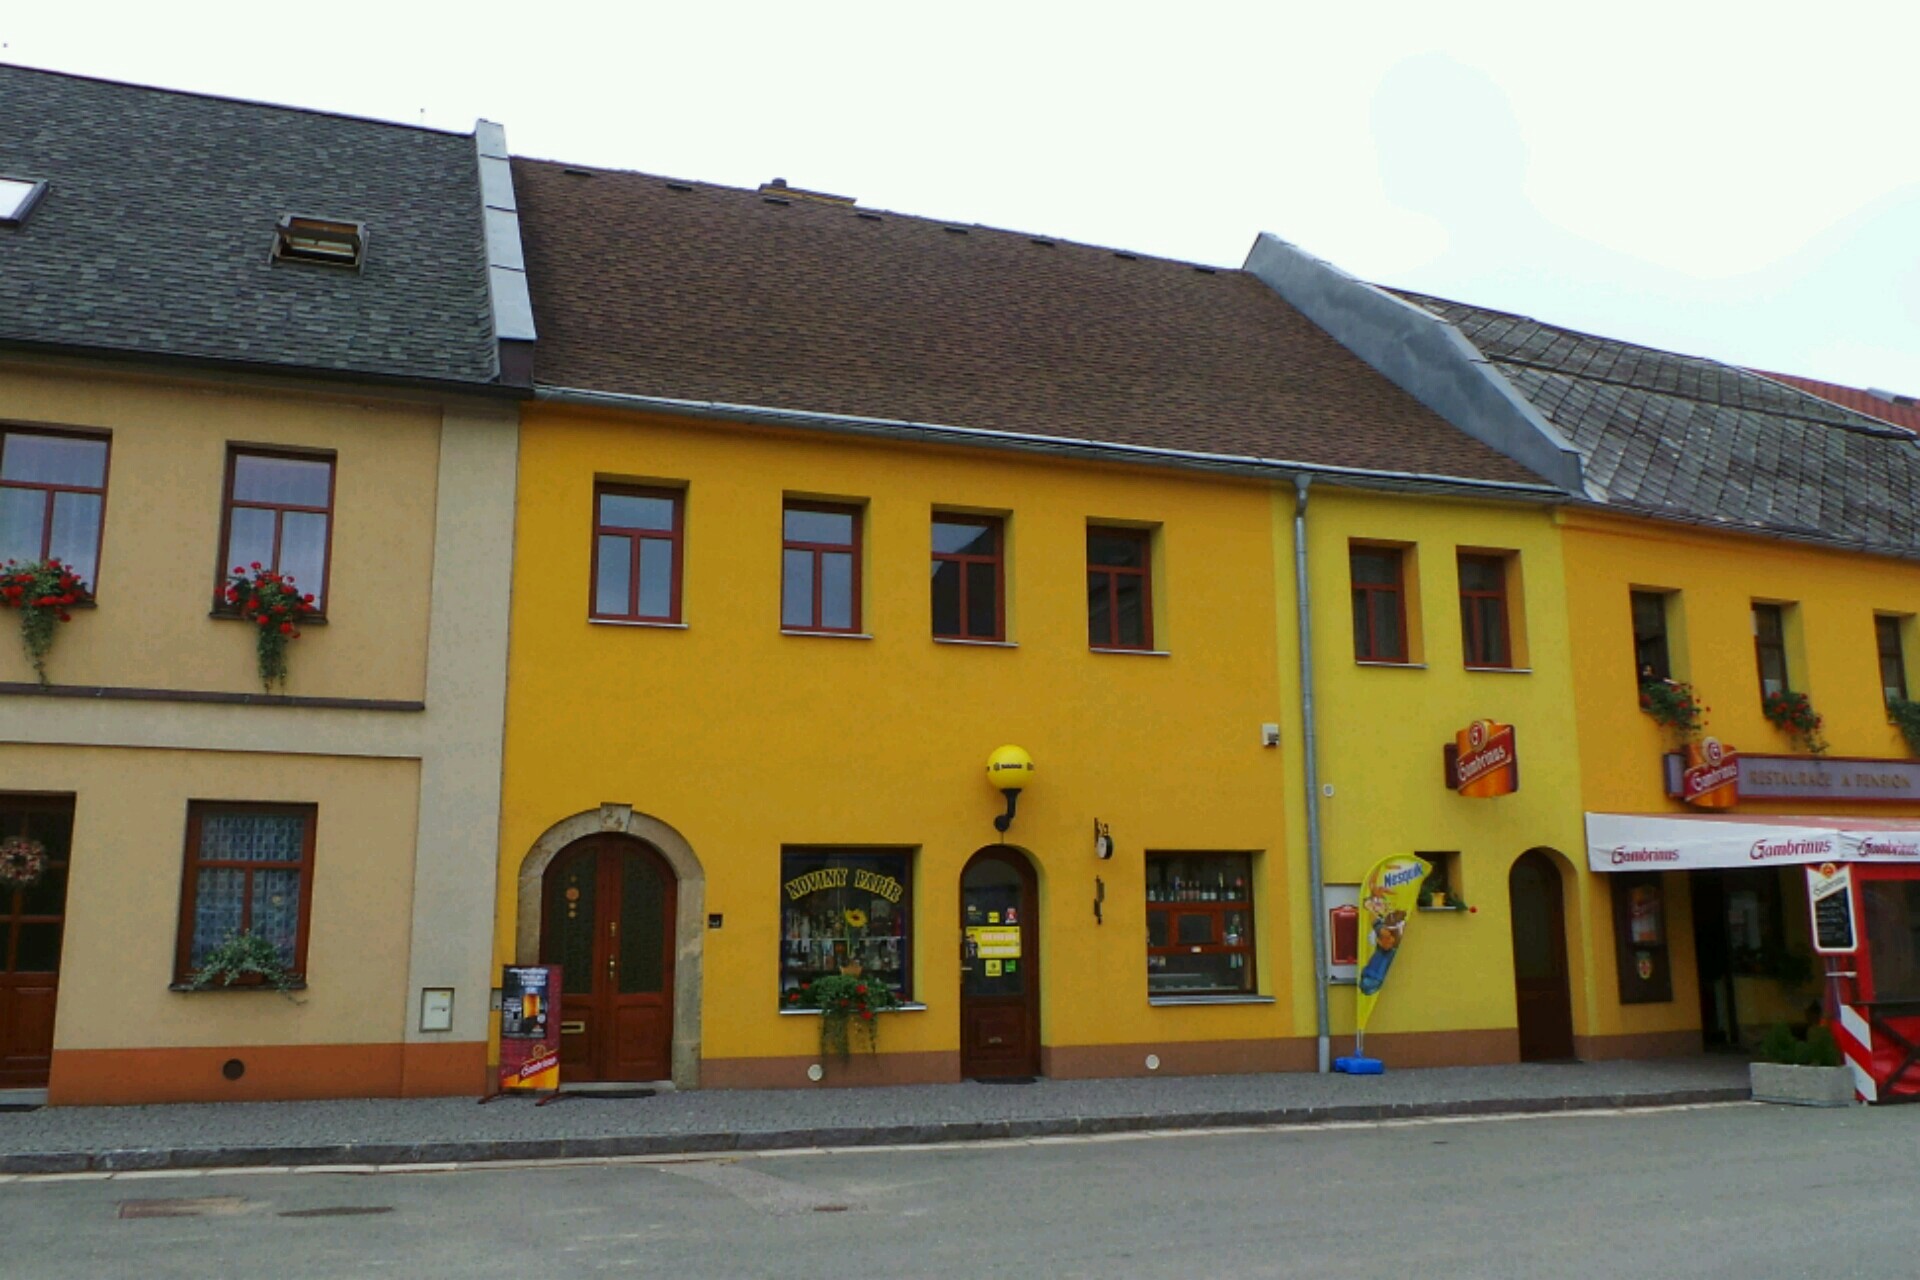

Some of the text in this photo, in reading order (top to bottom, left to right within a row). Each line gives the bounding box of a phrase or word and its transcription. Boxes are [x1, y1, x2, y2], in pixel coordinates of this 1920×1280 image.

[1457, 746, 1506, 782] Gambrinus
[1691, 764, 1737, 792] Gambrinus
[1855, 773, 1912, 789] PENSION
[1611, 845, 1680, 865] Gambrinus
[1749, 838, 1833, 861] Gambrinus
[1857, 837, 1919, 858] Gambrinus
[784, 867, 904, 904] NOVINY PAPÍR
[1384, 862, 1423, 888] Nesquik
